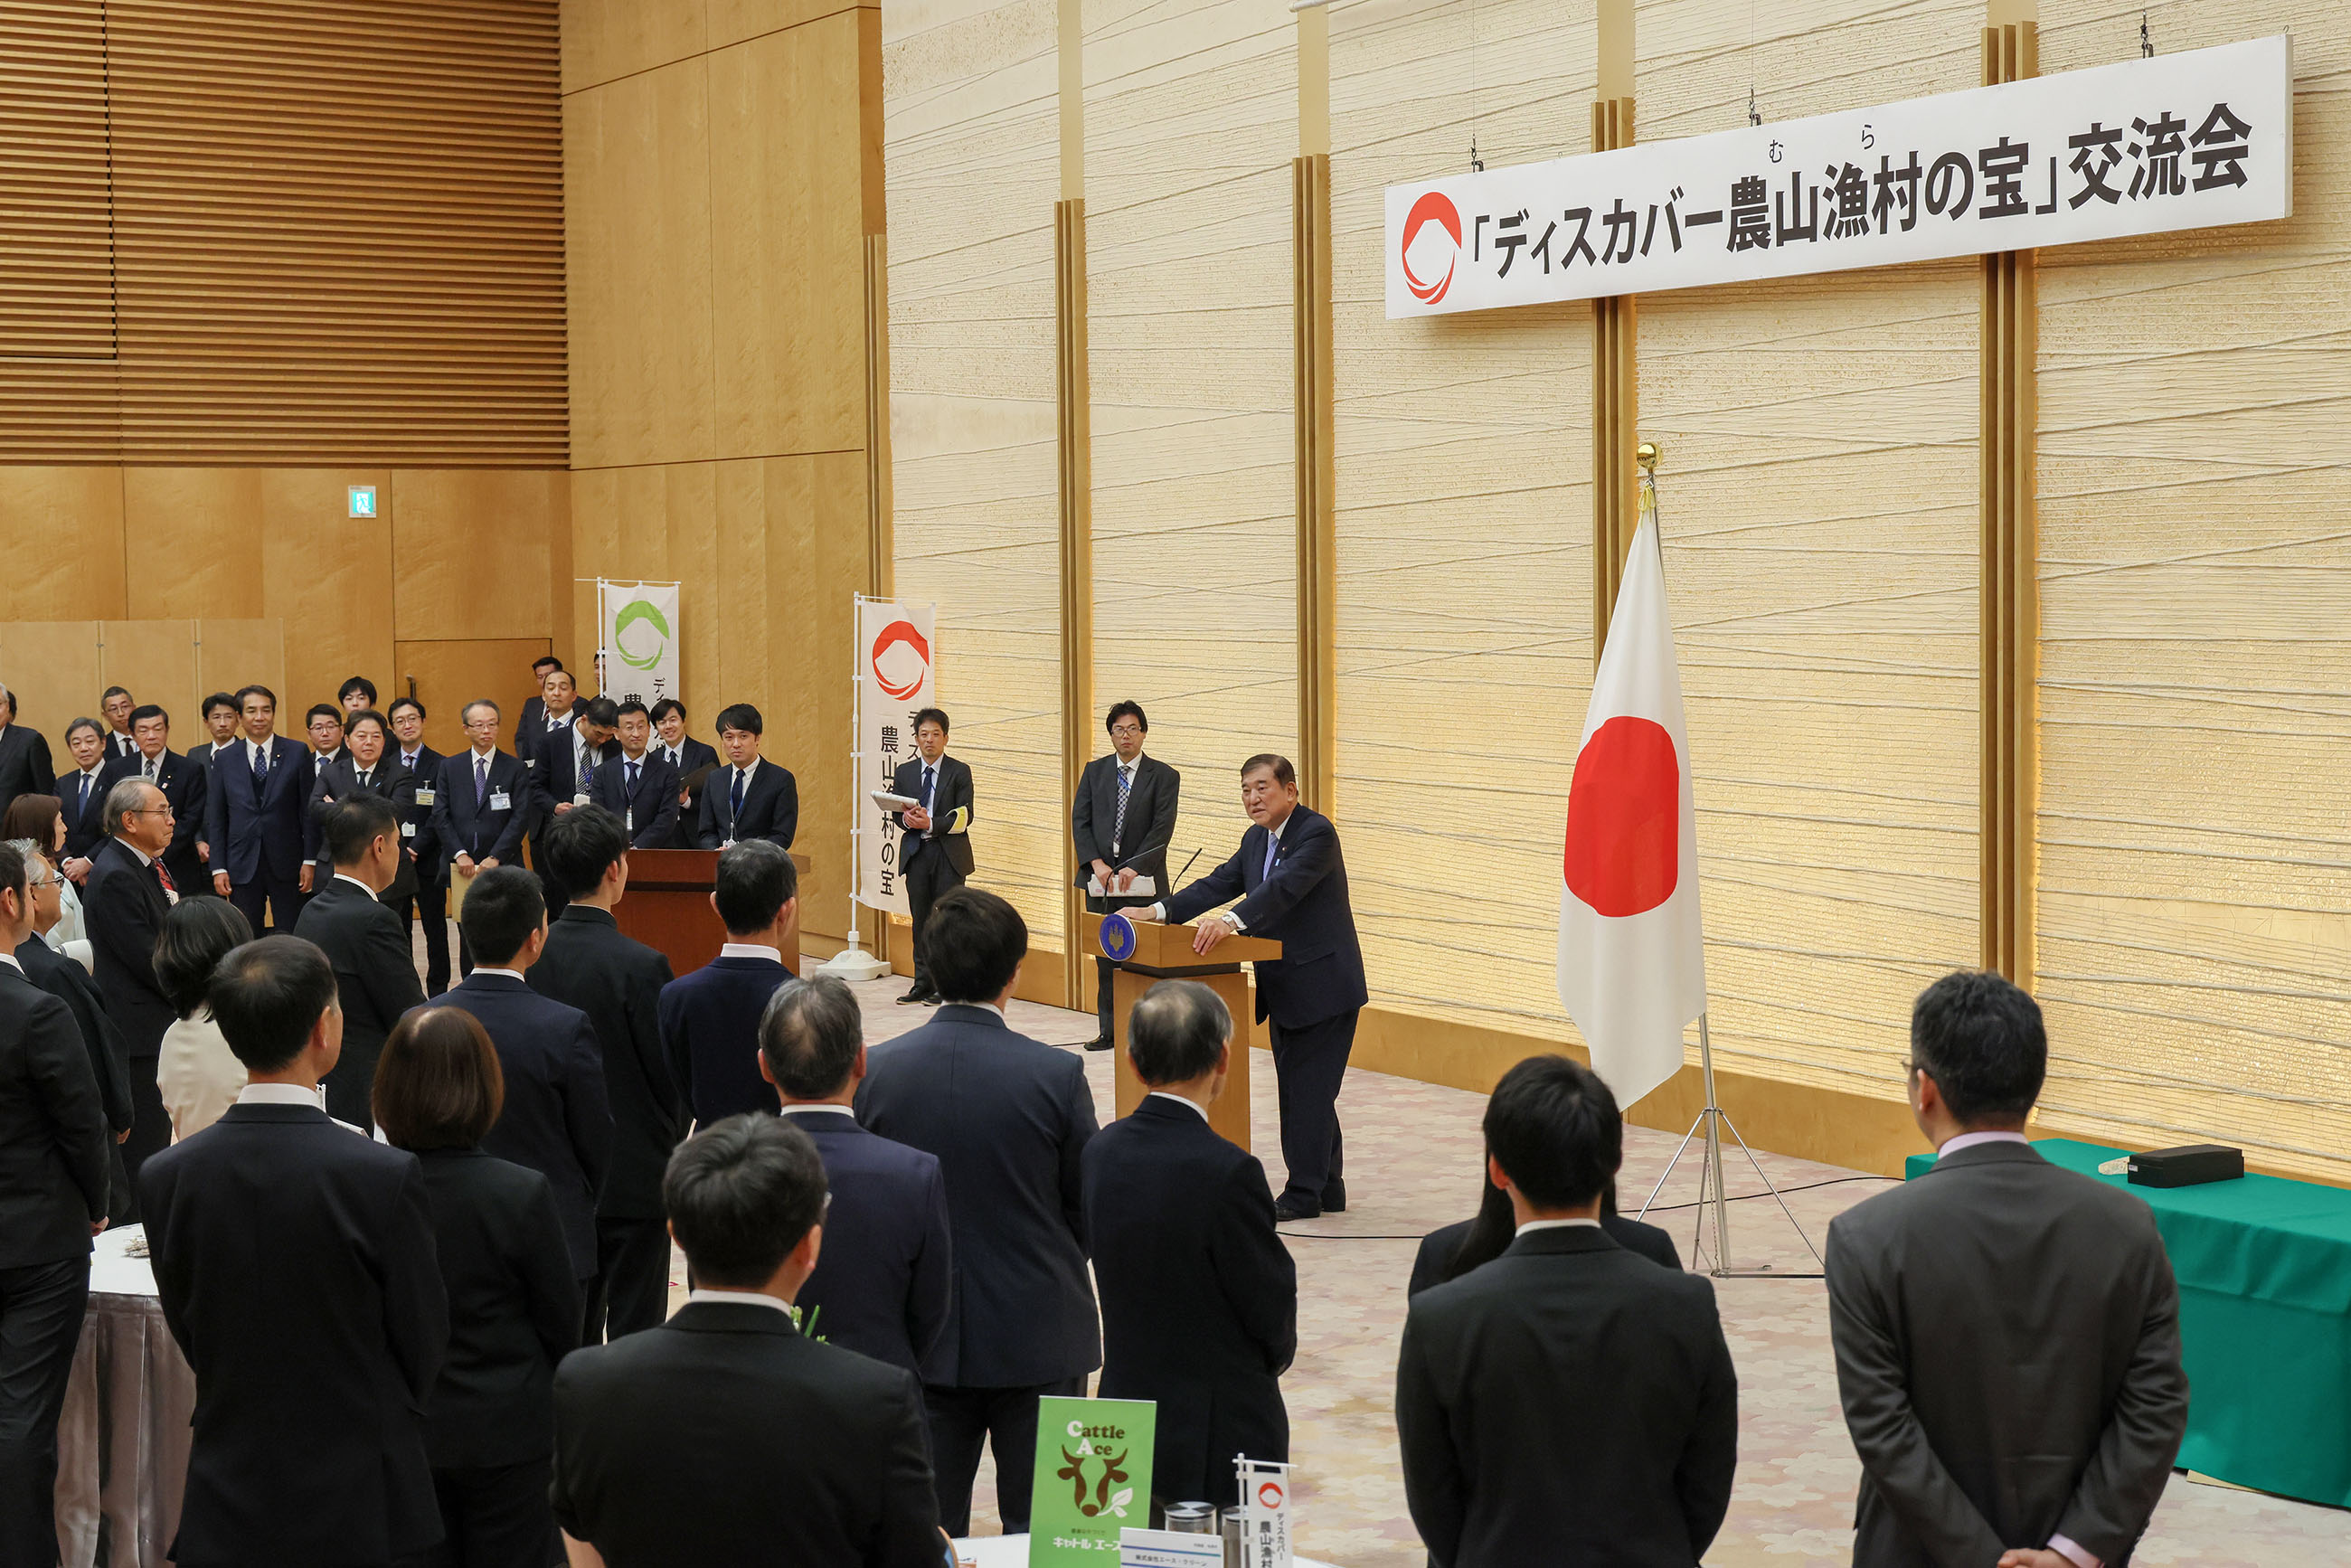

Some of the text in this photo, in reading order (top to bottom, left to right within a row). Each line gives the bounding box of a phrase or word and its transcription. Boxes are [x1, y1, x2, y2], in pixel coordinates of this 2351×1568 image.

[1472, 102, 2252, 279] 「ディスカバー農山漁村の宝」交流会
[880, 725, 899, 896] 農山村の宝
[1067, 1420, 1125, 1439] Cattle
[1076, 1438, 1112, 1455] Ace
[1053, 1536, 1091, 1550] キャトル
